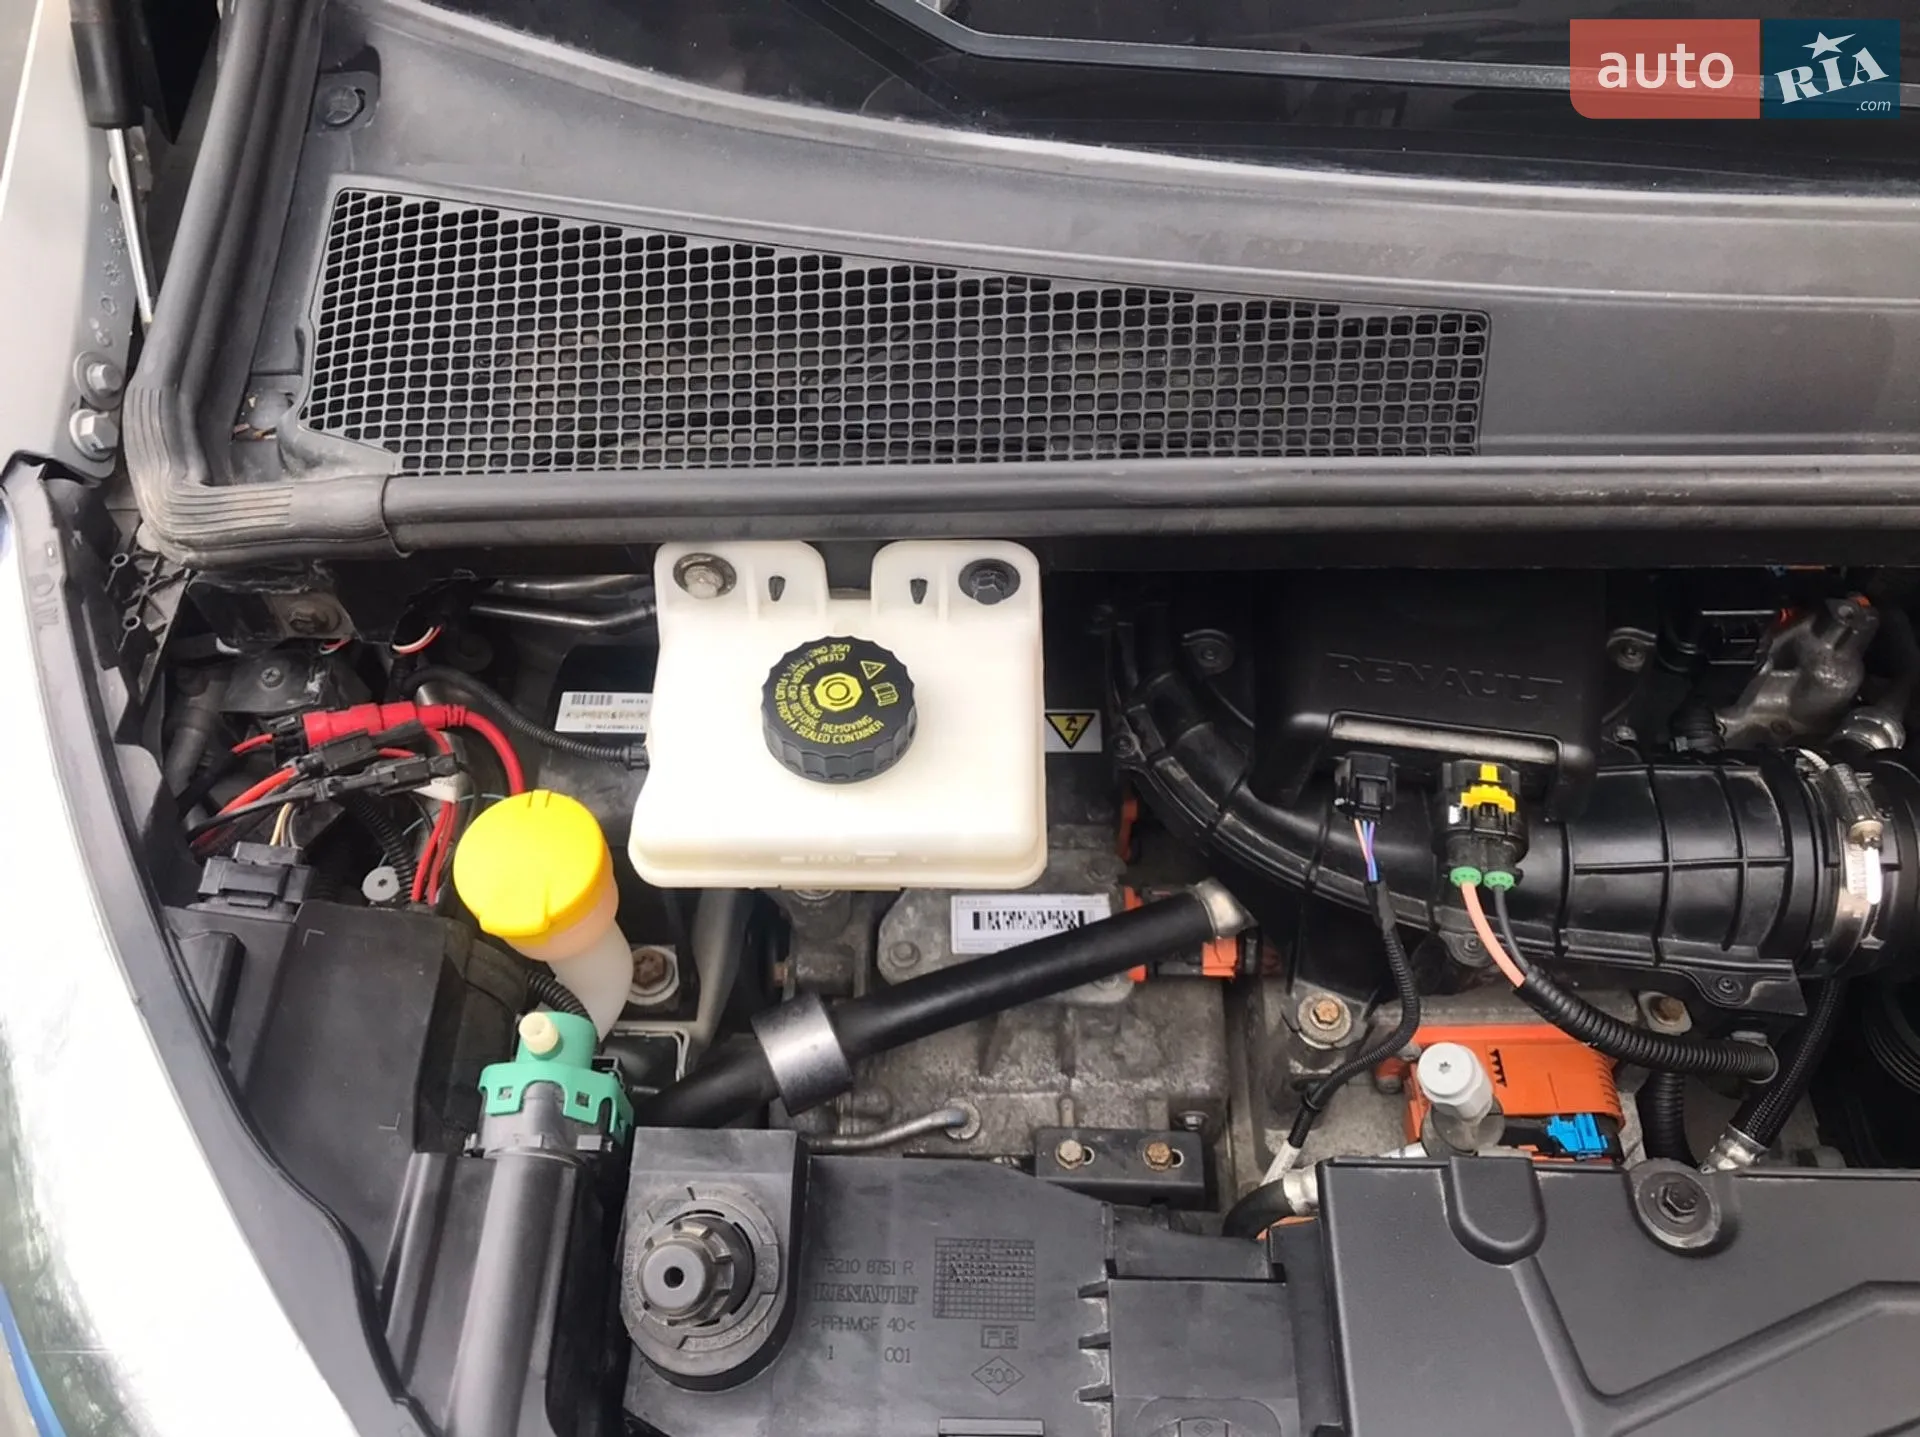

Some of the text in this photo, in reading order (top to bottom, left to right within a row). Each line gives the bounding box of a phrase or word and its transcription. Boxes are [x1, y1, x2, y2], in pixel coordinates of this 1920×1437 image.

[1326, 652, 1563, 702] RENAULT
[796, 725, 831, 743] SEALED
[832, 719, 885, 744] CONTAINER
[820, 714, 873, 733] REMOVING
[814, 1283, 920, 1305] RENAULT
